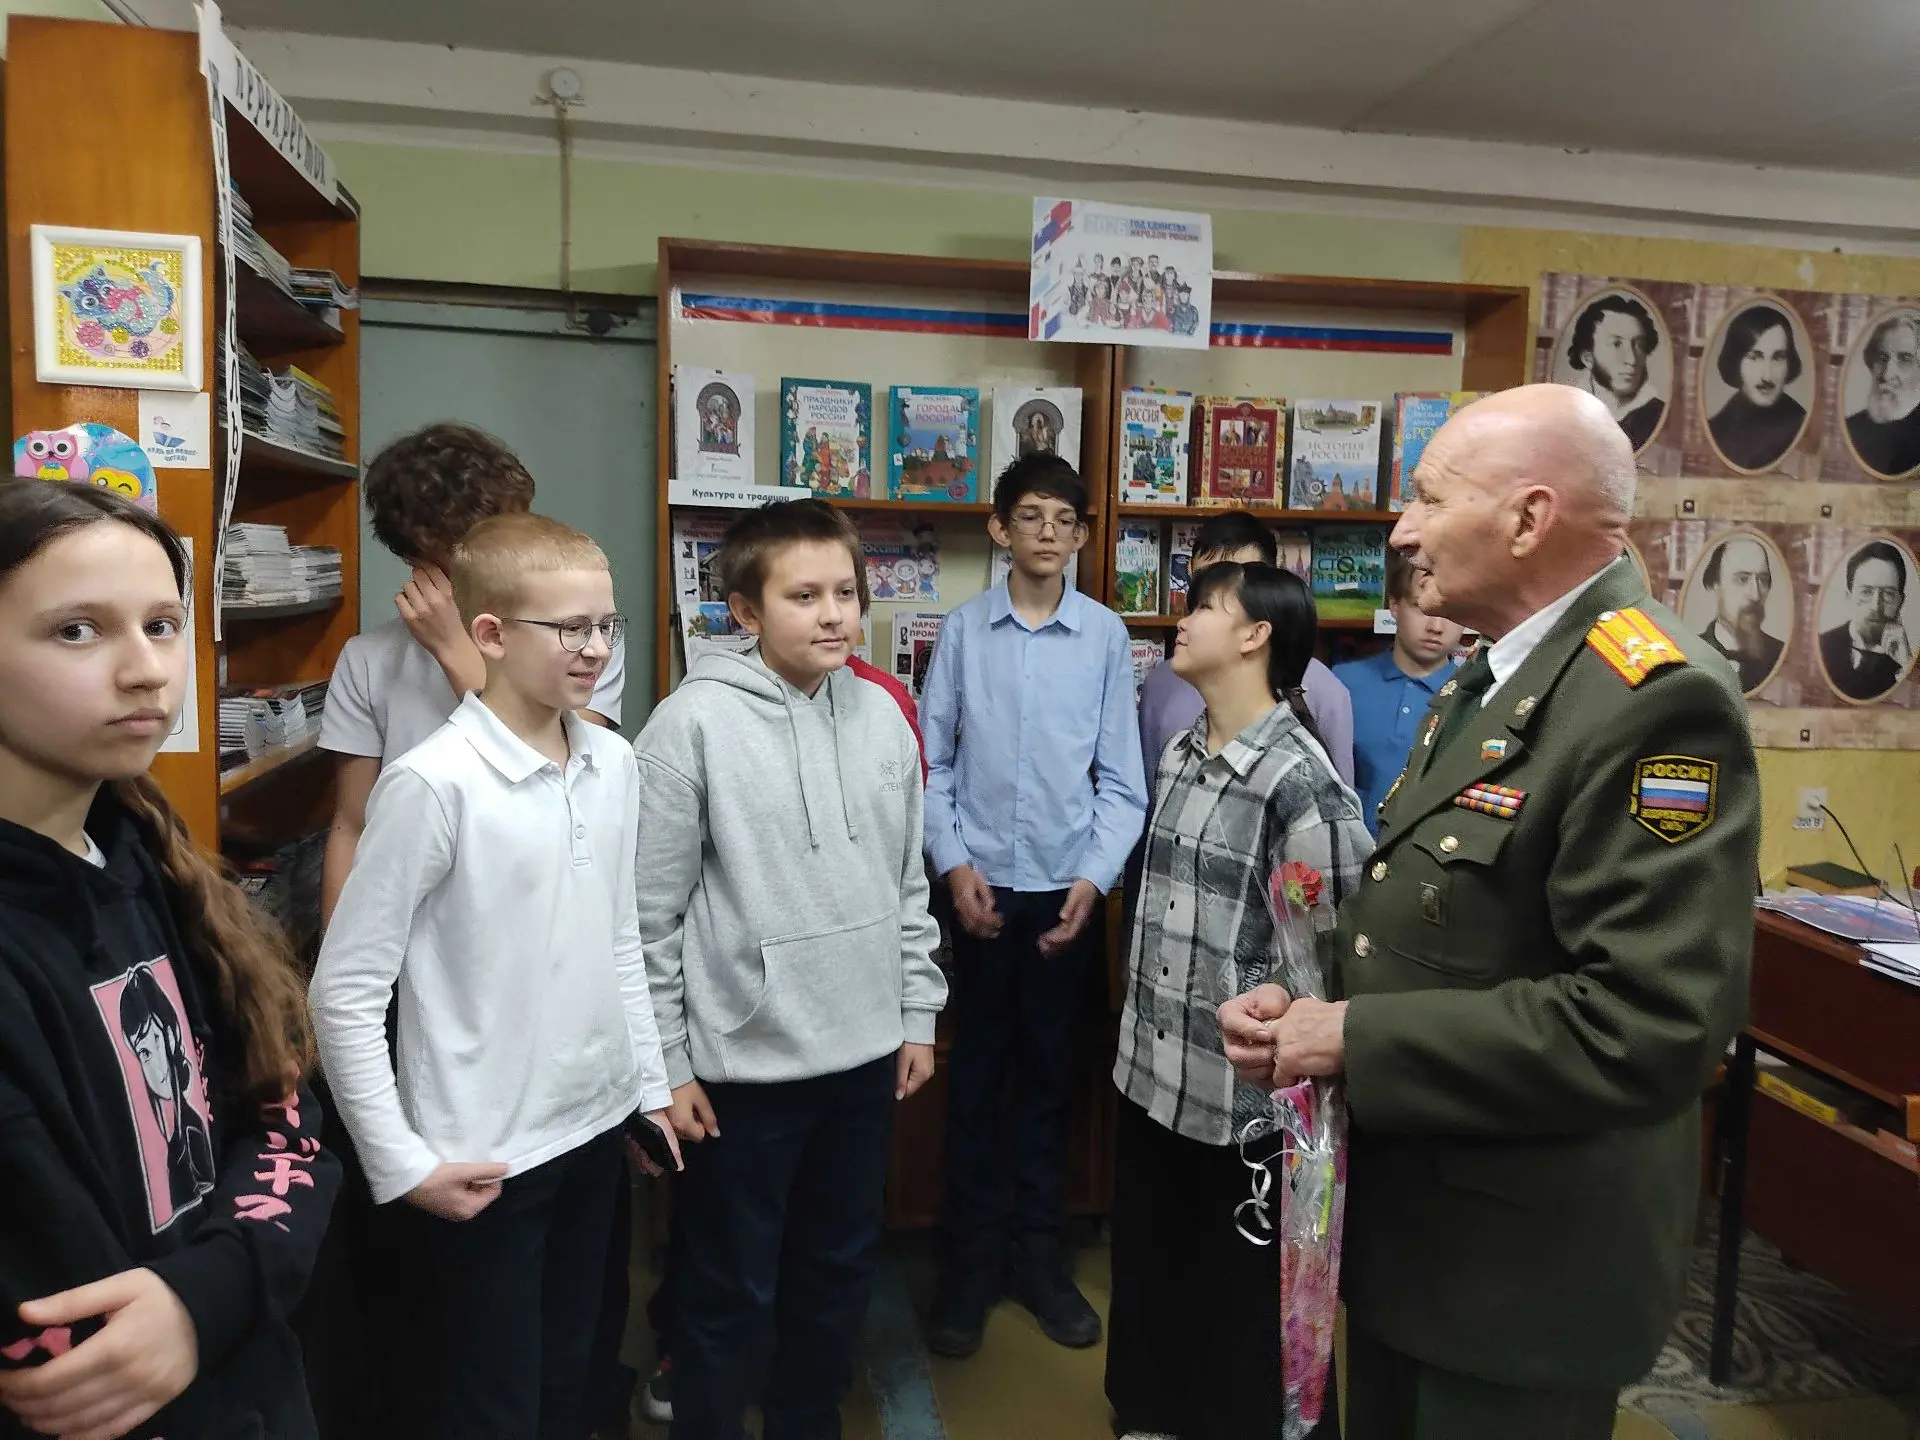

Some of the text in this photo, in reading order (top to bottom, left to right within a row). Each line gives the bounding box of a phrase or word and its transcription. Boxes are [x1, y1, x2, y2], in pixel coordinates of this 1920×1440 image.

[803, 395, 853, 406] ПРАЗДНИКИ
[808, 404, 848, 414] НАРОДОВ
[810, 411, 846, 421] РОССИИ
[1125, 408, 1160, 422] РОССИЯ
[1308, 441, 1364, 451] ИСТОРИЯ
[1311, 451, 1361, 461] РОССИИ
[692, 488, 735, 499] Культура
[1642, 763, 1711, 781] РОССИЯ
